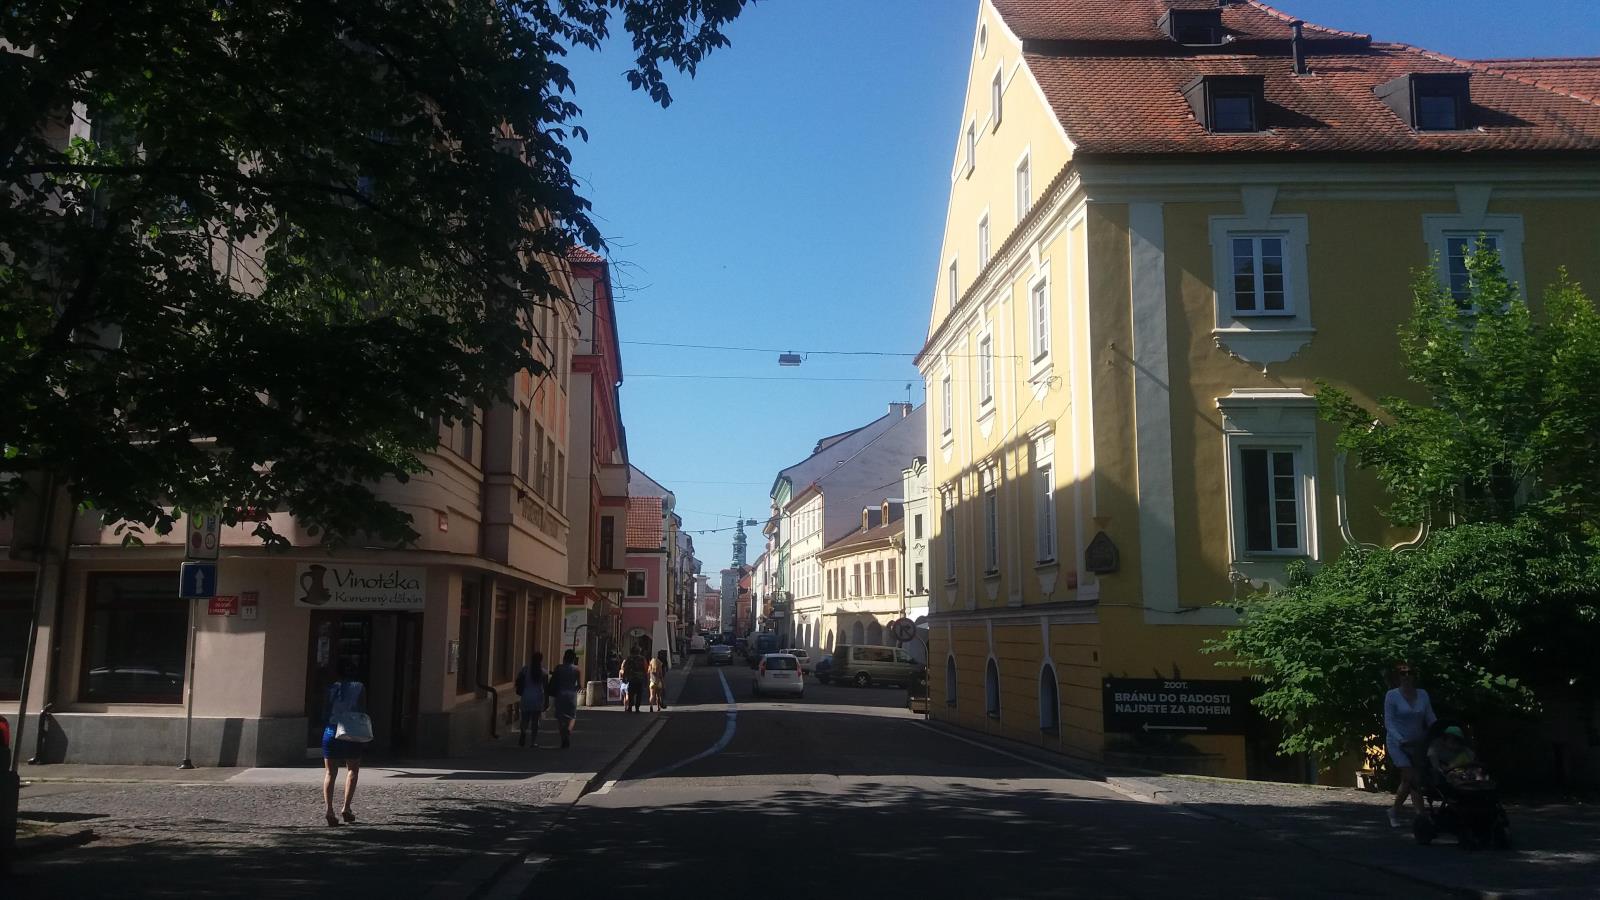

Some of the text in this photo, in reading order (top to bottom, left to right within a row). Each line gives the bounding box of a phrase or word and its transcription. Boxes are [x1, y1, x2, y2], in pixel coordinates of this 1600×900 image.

[332, 568, 420, 590] Vinotéka
[1114, 690, 1230, 704] BRÁNU DO RADOSTI
[1115, 704, 1231, 715] NAJDETE ZA ROHEM
